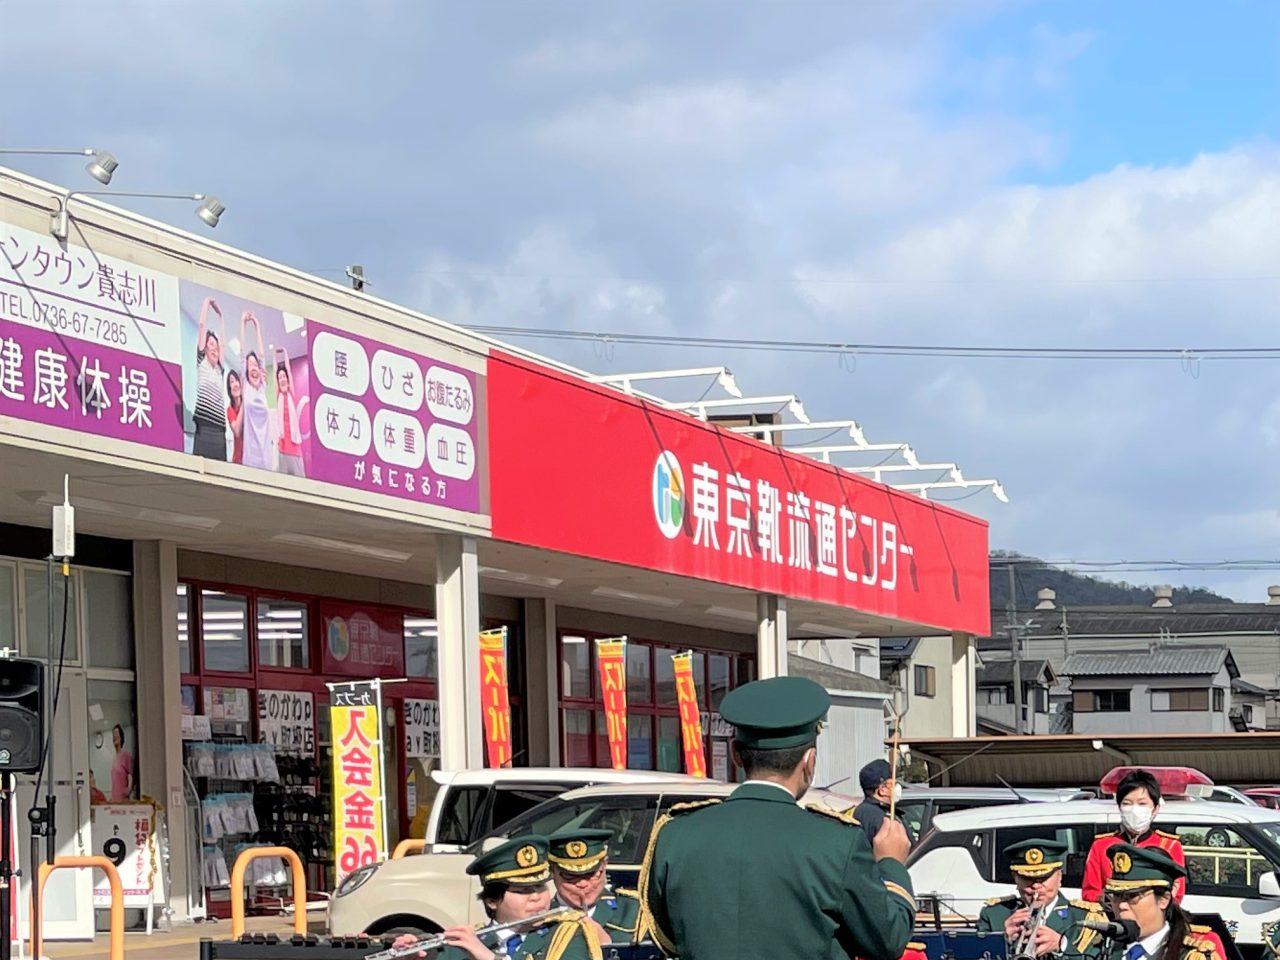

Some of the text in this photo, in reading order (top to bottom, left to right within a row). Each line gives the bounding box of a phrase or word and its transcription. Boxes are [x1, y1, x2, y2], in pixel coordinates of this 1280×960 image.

[0, 236, 156, 313] ンタウン貴志川
[334, 350, 348, 379] 腰
[381, 366, 414, 397] ひざ
[0, 336, 152, 428] 健康体操
[327, 406, 361, 440] 体力
[384, 421, 416, 455] 体重
[437, 436, 467, 466] 血圧
[354, 461, 446, 499] が気になる方
[692, 461, 914, 591] 東京靴流通センター
[103, 838, 127, 867] 9
